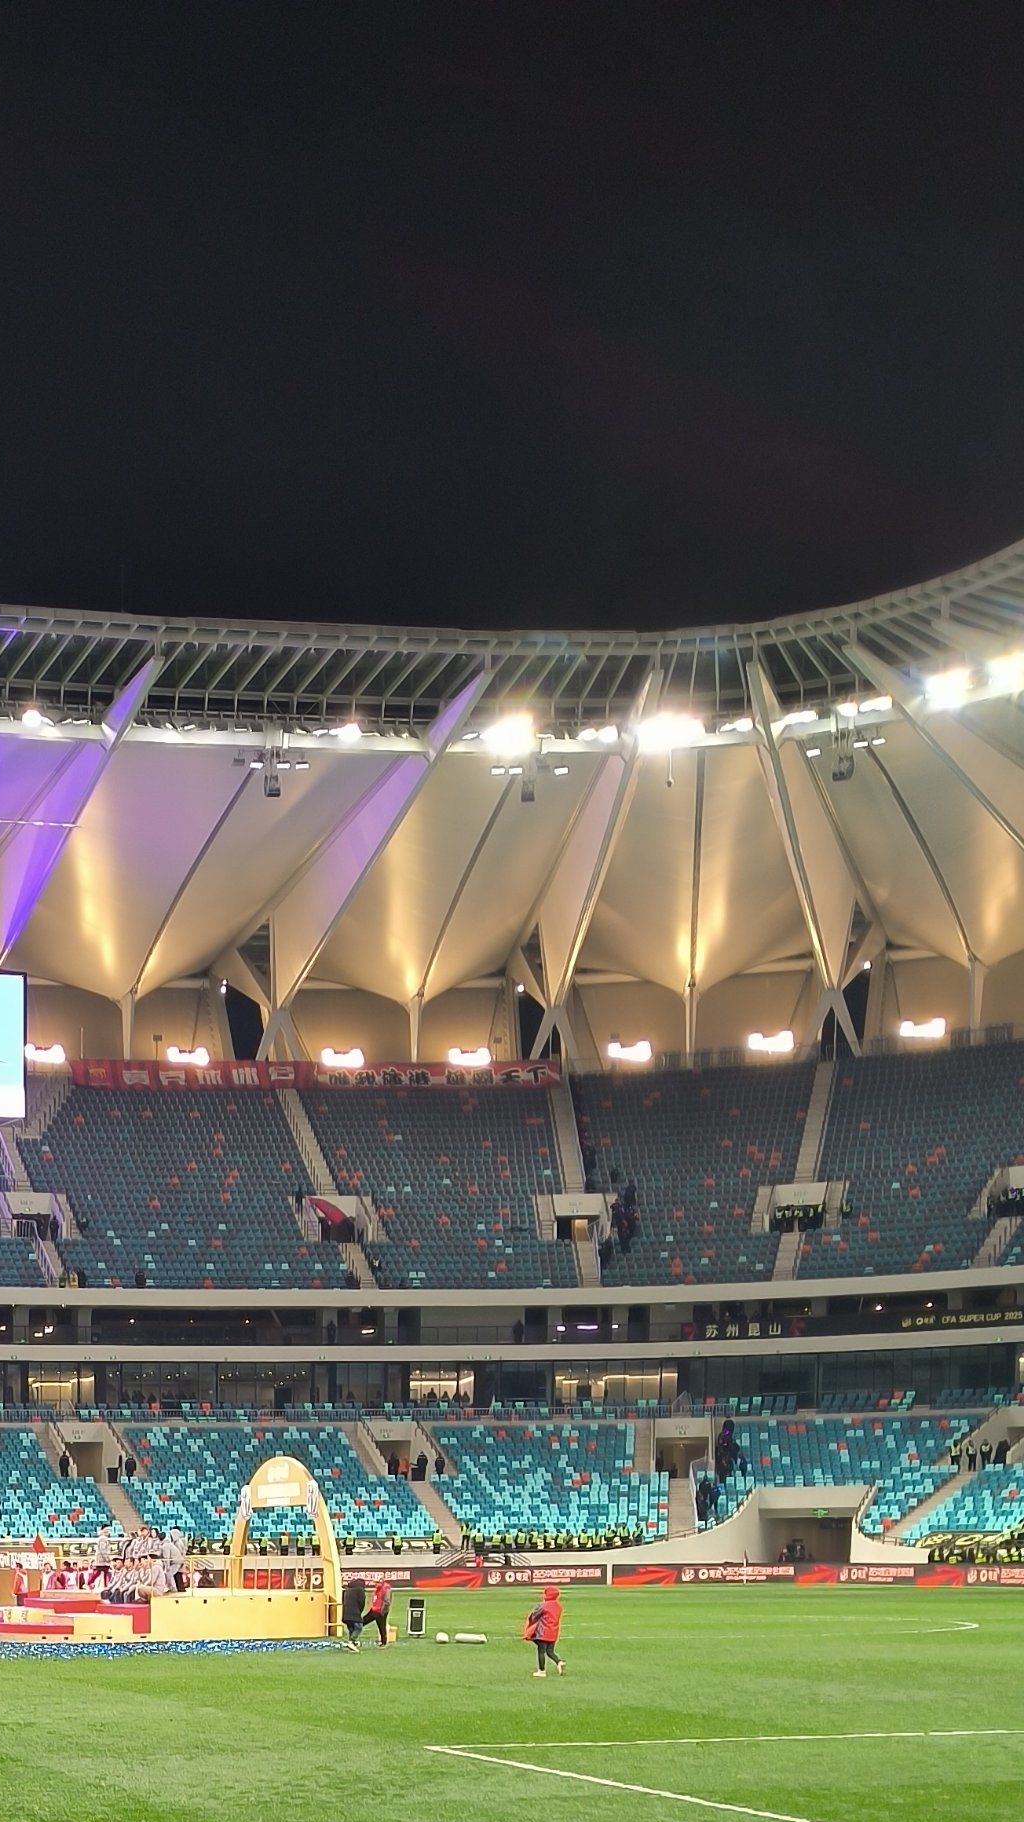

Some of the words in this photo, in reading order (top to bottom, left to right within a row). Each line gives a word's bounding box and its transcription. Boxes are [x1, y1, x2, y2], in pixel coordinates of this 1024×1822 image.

[941, 1315, 957, 1324] CFA
[958, 1314, 985, 1323] SUPER
[986, 1312, 1002, 1322] CUP
[1004, 1310, 1024, 1320] 2025
[705, 1321, 782, 1338] 苏州昆山
